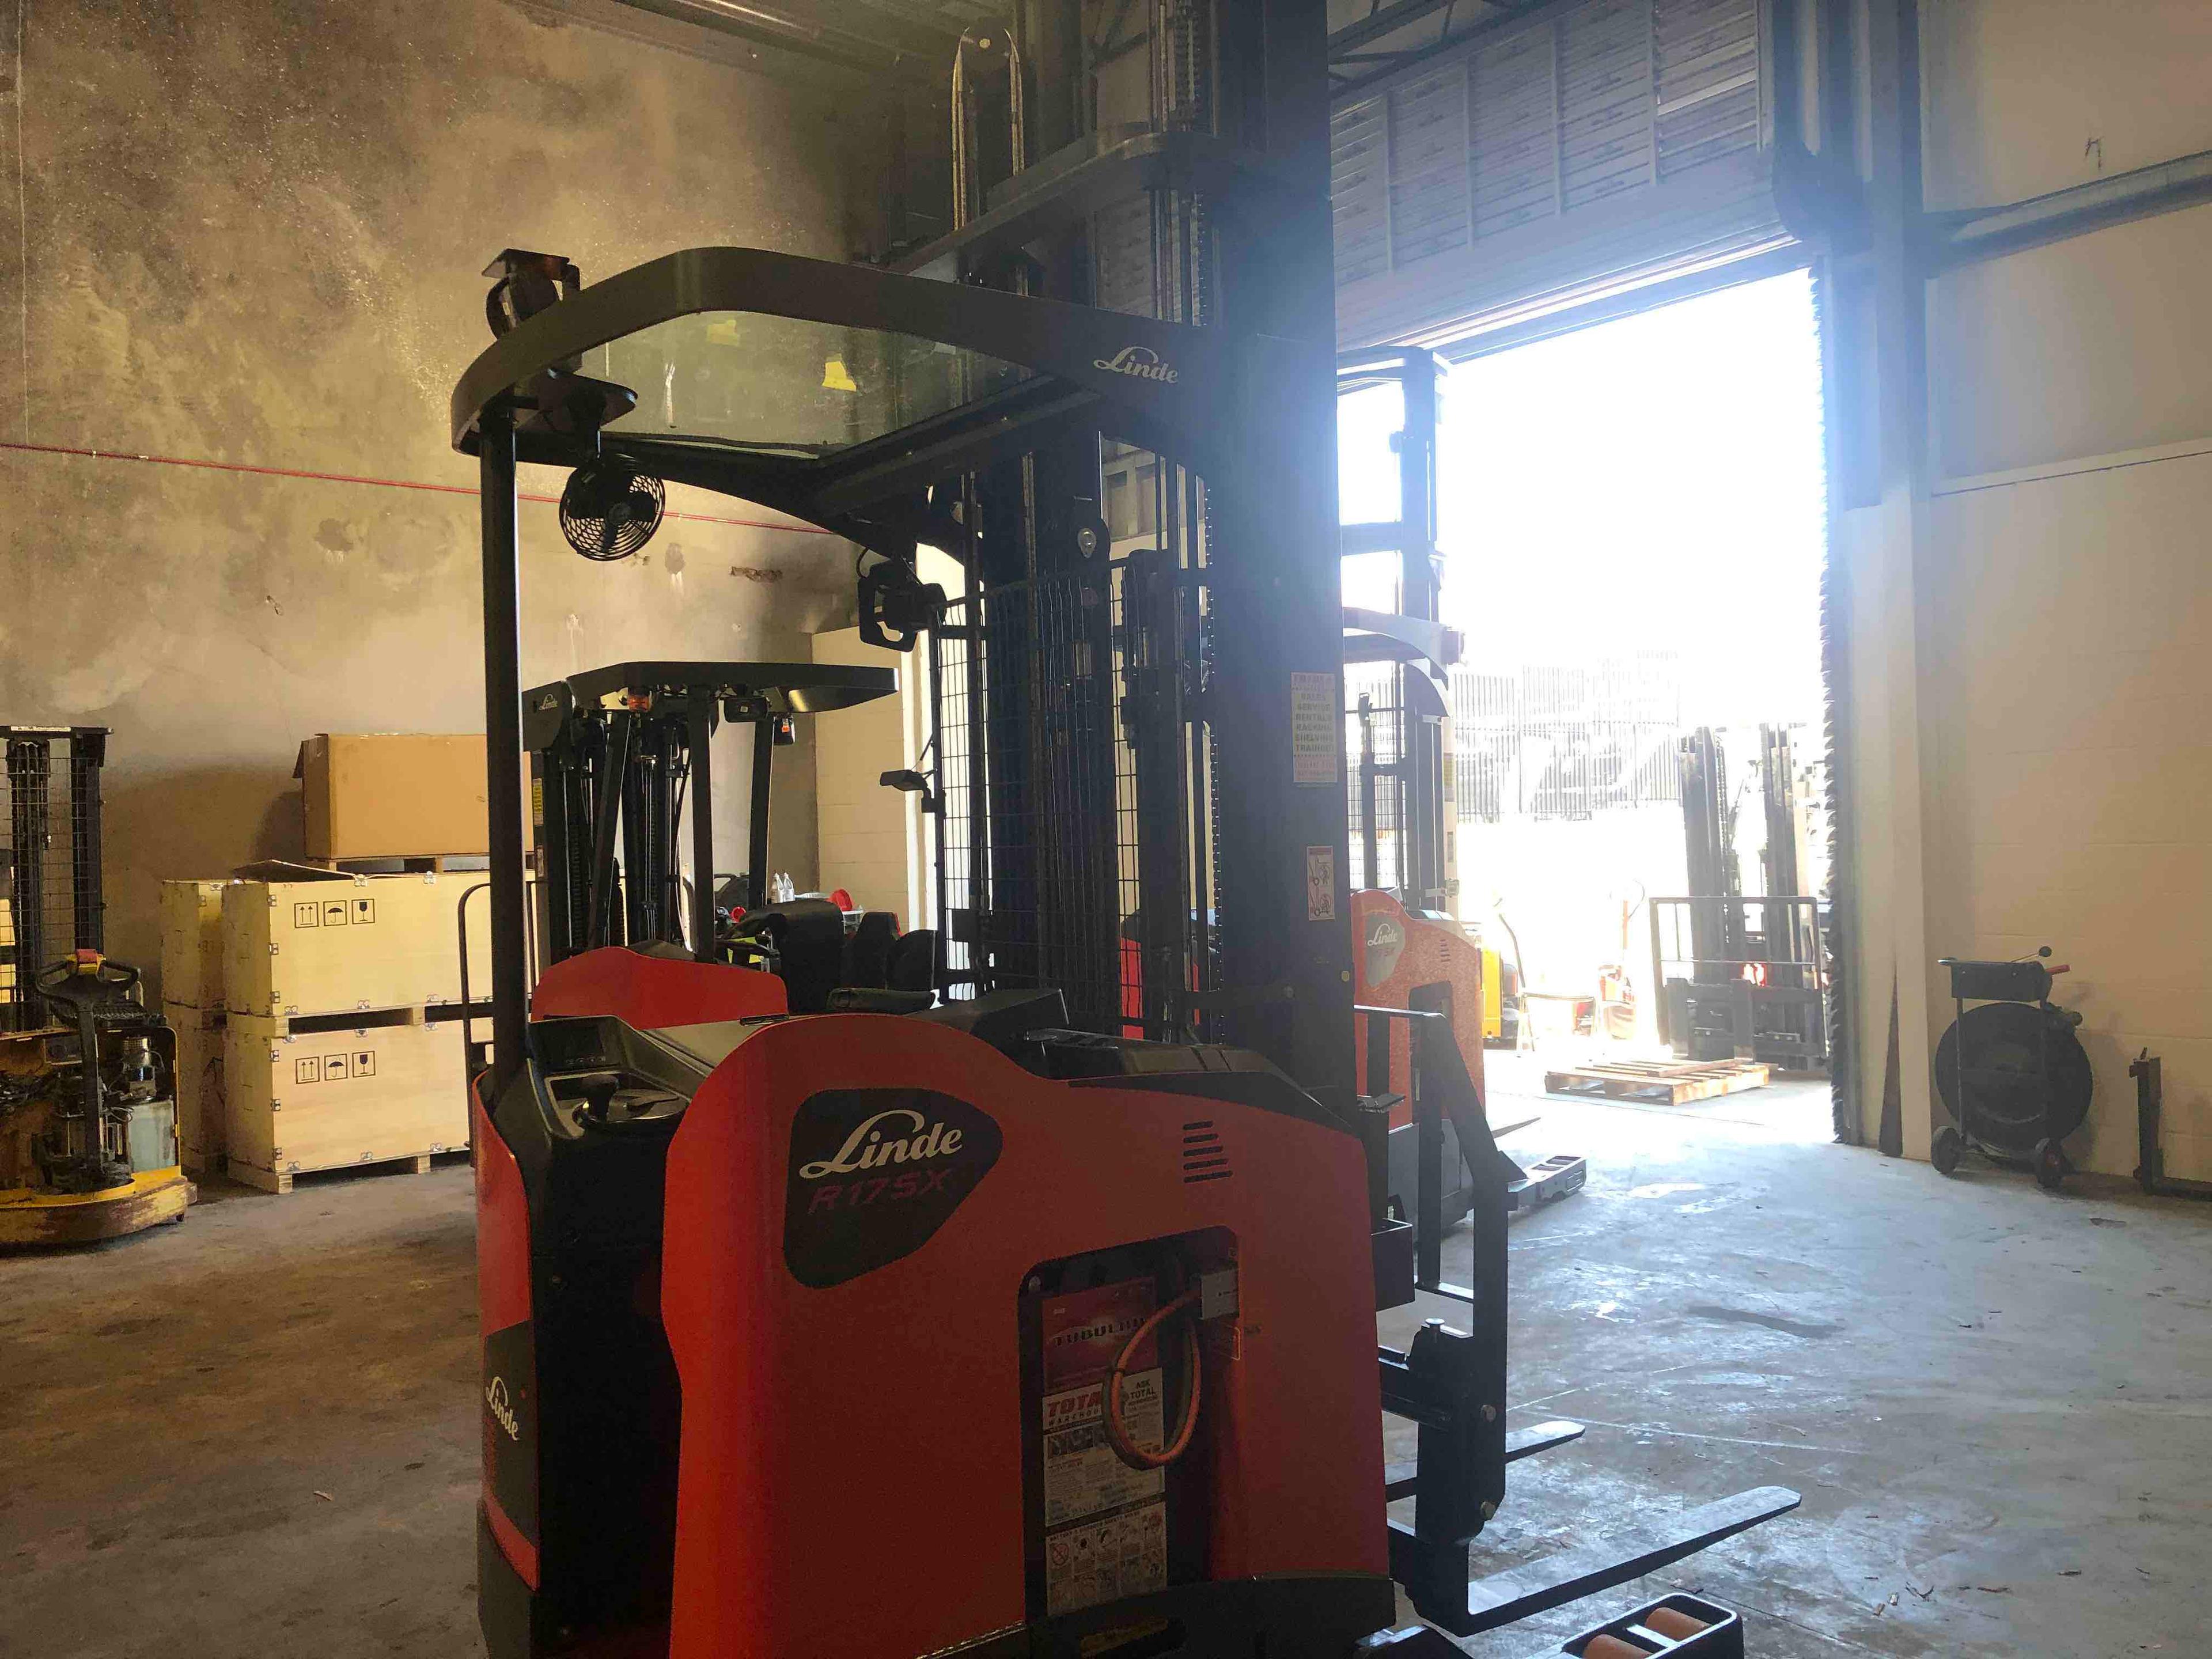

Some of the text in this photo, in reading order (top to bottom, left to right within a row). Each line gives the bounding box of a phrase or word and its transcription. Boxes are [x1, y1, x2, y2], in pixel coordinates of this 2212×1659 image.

[1093, 346, 1178, 384] Linde
[1367, 923, 1398, 946] Linde
[799, 1109, 963, 1179] Linde
[808, 1167, 952, 1215] R17SX
[486, 1376, 518, 1441] Linde
[1047, 1391, 1103, 1418] TOTA
[1130, 1387, 1157, 1399] TOTAL
[1048, 1407, 1102, 1427] WAREHOU
